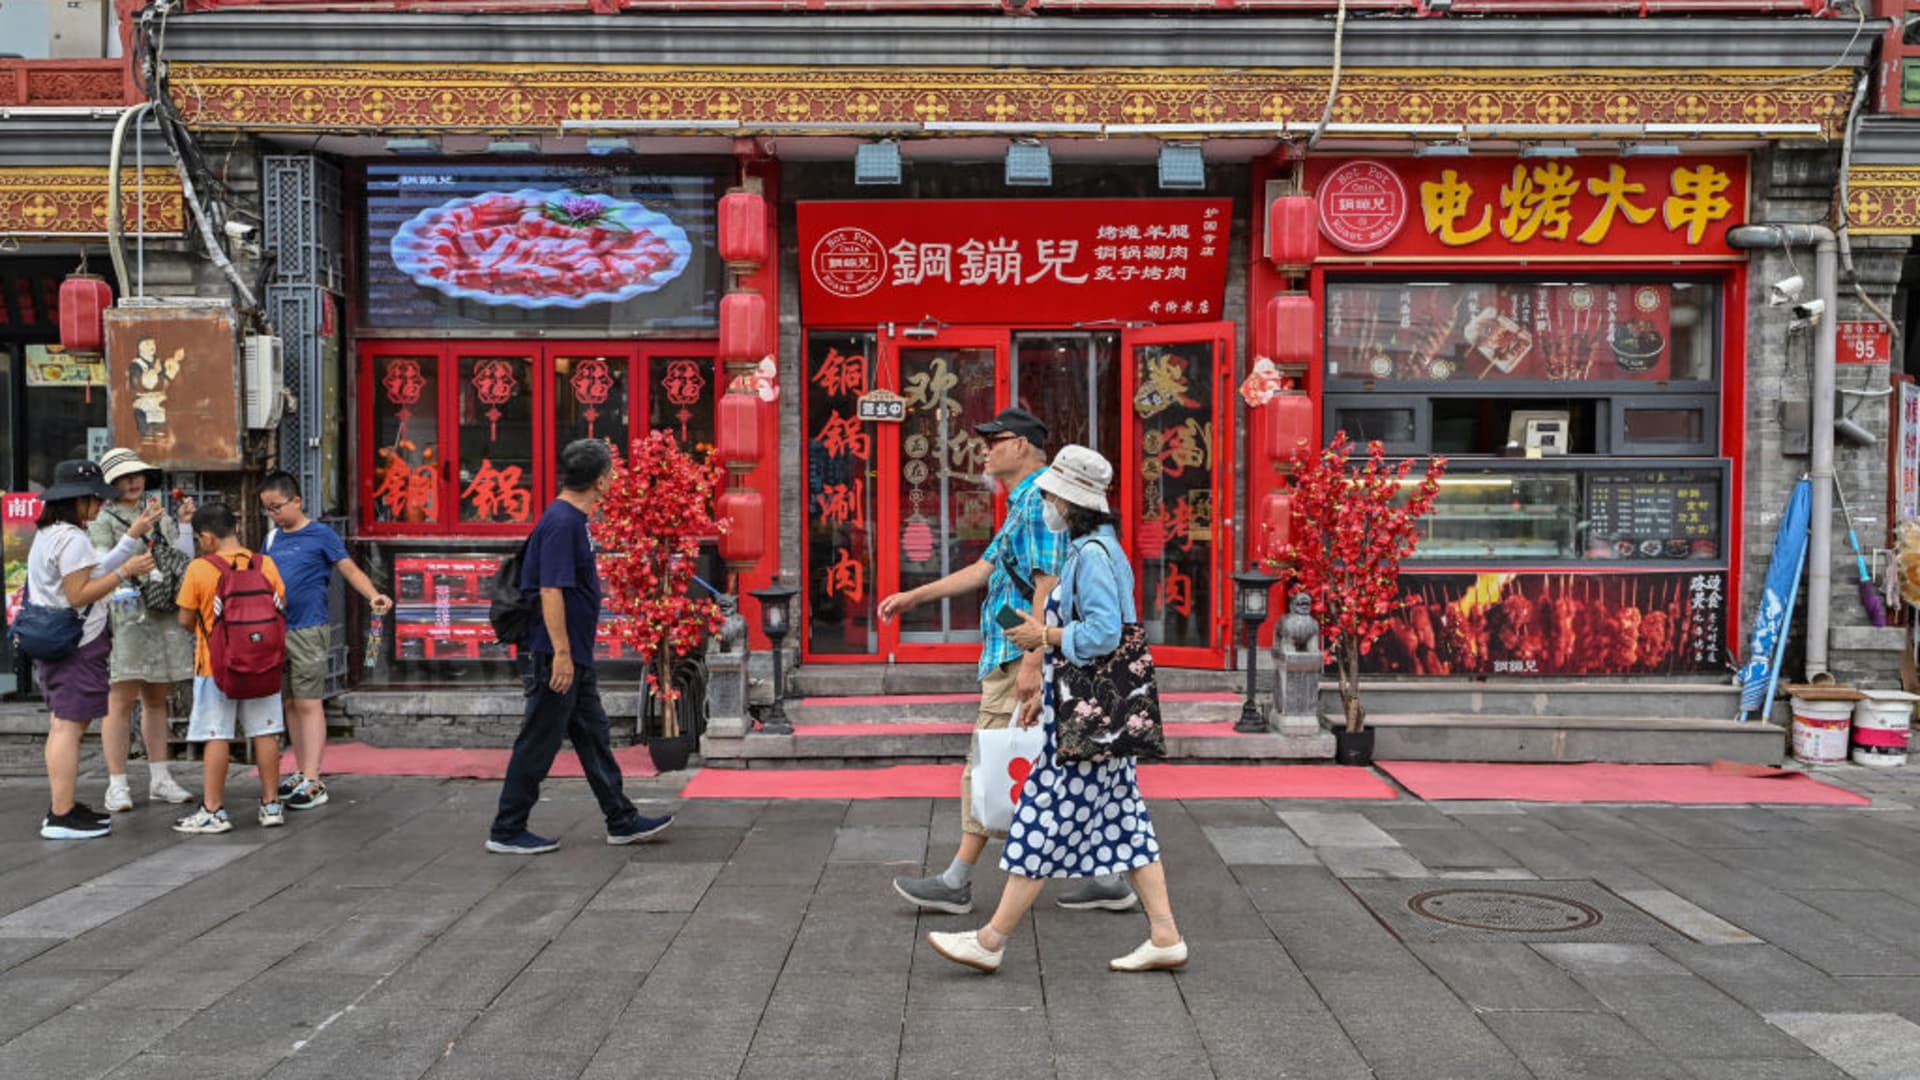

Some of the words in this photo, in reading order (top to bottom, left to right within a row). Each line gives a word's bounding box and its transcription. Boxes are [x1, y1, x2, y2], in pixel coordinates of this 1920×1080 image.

[1368, 166, 1391, 185] Pot
[1420, 163, 1733, 246] 电烤大串
[1094, 245, 1189, 261] 铜锅涮肉
[1093, 265, 1187, 281] 炙子烤肉
[1855, 339, 1876, 359] 95
[903, 357, 987, 482] 欢迎
